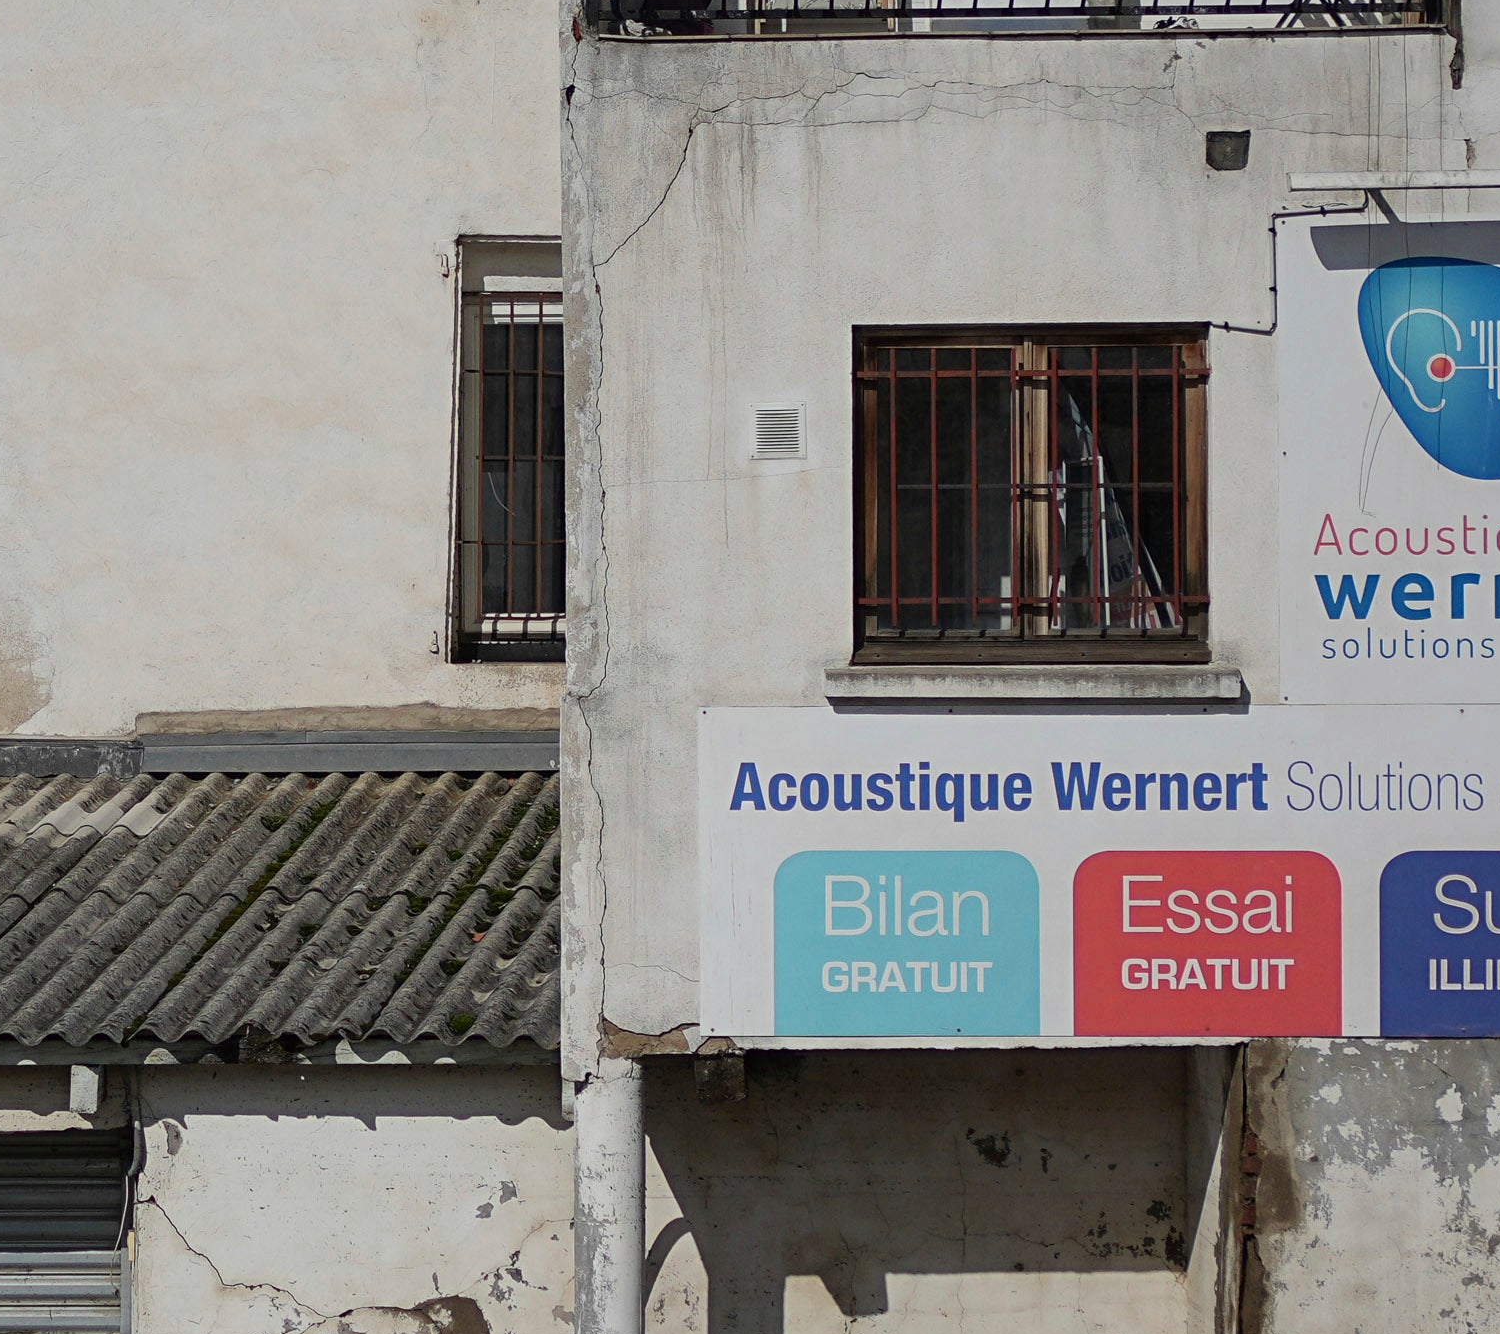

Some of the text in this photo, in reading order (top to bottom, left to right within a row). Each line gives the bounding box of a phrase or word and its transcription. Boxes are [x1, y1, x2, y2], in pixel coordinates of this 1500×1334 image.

[1321, 626, 1496, 660] solutions
[729, 761, 1033, 823] Acoustique
[1050, 761, 1269, 812] Wernert
[1286, 760, 1485, 813] Solutions
[823, 874, 990, 937] Bilan
[1121, 874, 1294, 934] Essai
[821, 960, 993, 993] GRATUIT
[1121, 957, 1295, 990] GRATUIT
